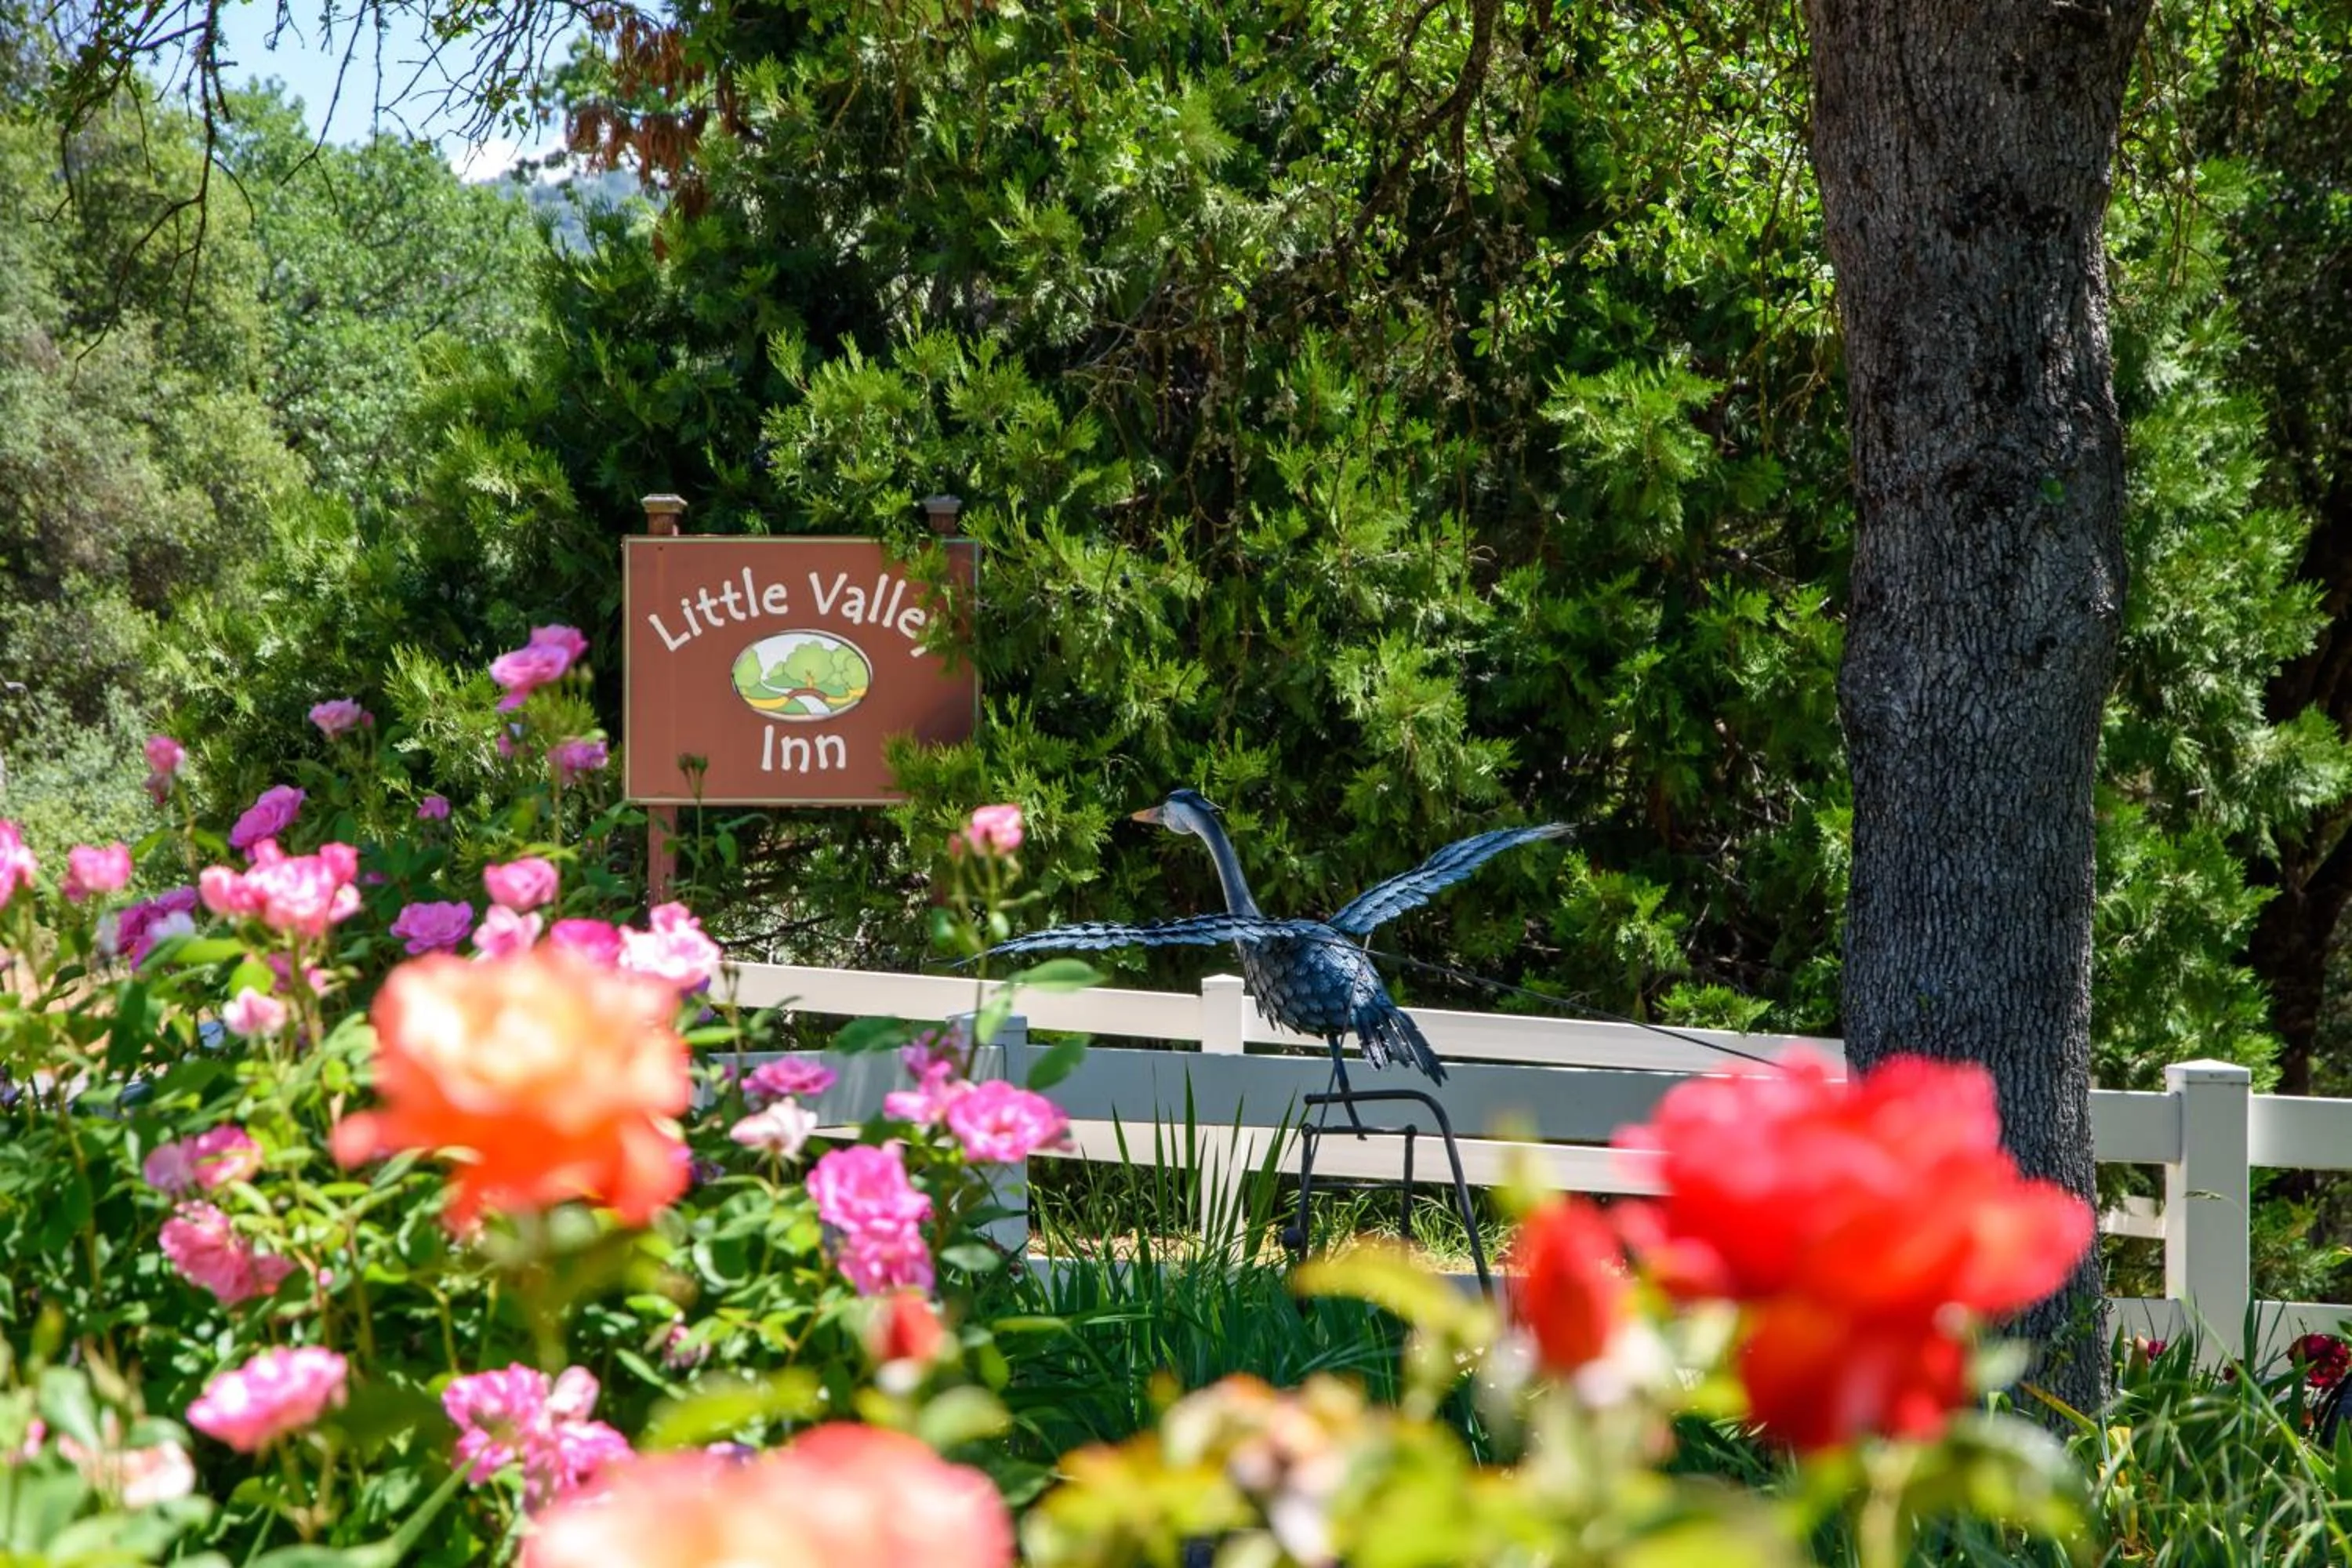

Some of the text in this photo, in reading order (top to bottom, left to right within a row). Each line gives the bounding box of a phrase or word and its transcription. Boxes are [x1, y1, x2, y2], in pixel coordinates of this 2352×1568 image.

[648, 566, 928, 659] Little Valle
[760, 724, 847, 773] Inn
